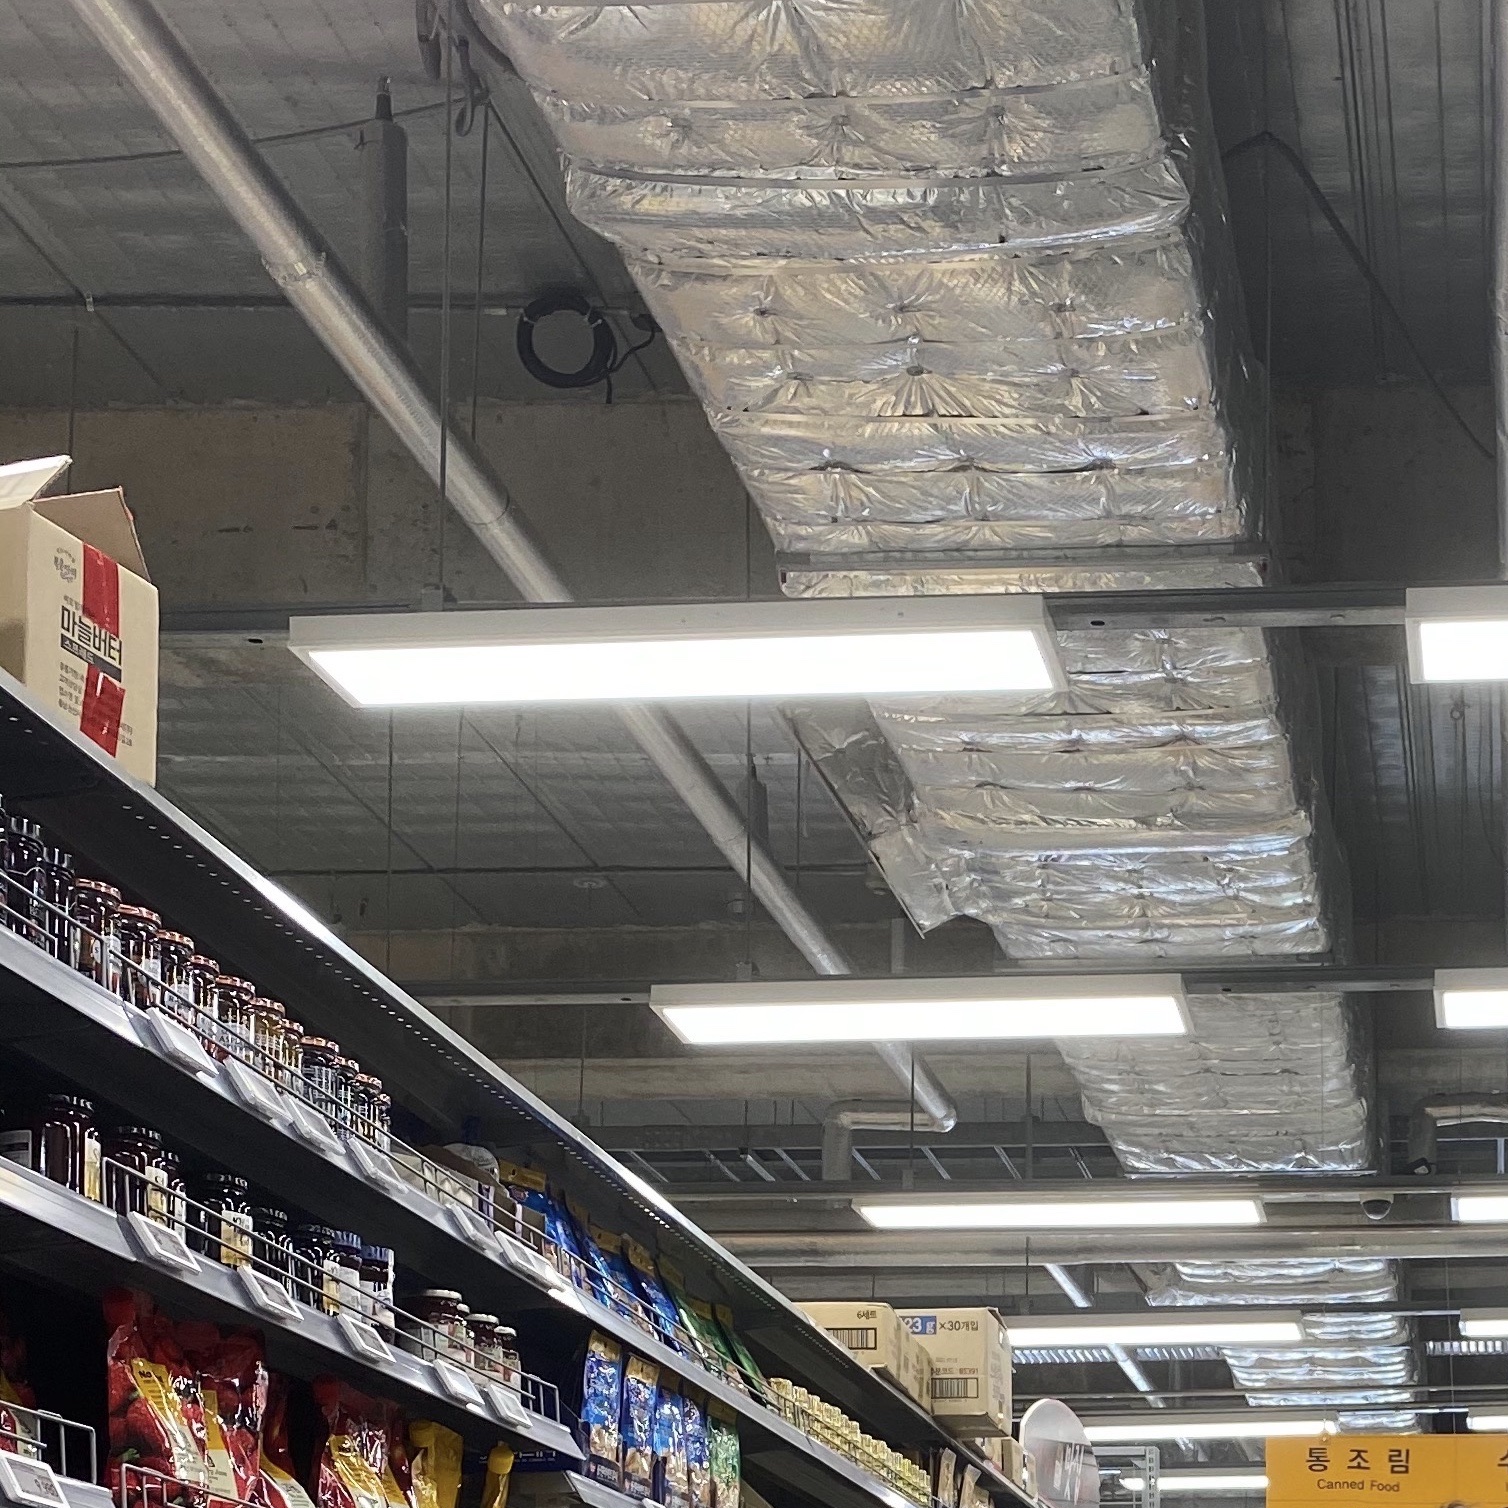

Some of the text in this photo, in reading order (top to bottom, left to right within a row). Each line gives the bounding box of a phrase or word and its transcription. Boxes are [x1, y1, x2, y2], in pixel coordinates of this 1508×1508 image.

[61, 604, 122, 666] 마늘버터
[856, 1310, 877, 1320] 6세트
[1316, 1478, 1401, 1493] Canned Food
